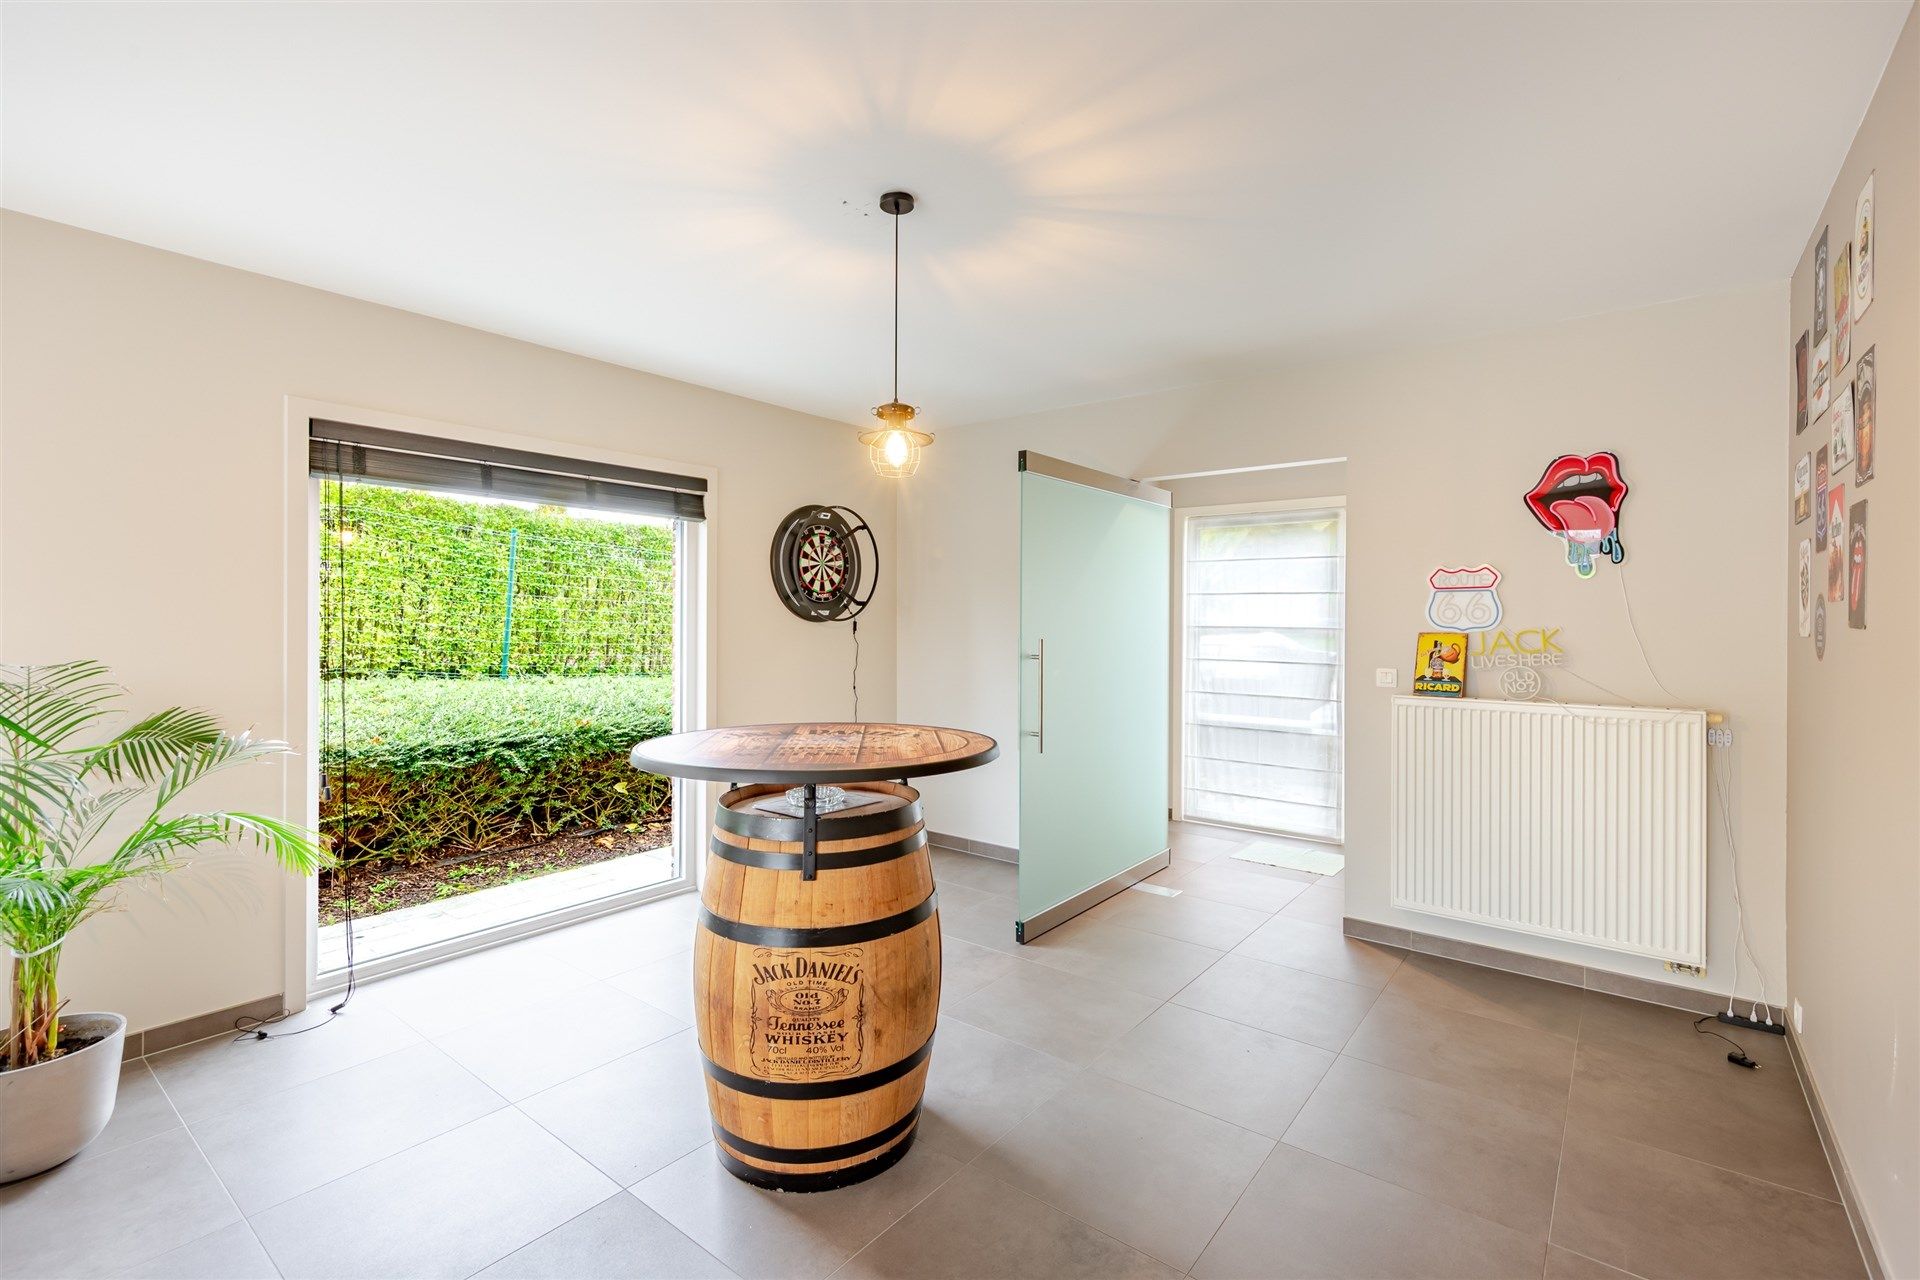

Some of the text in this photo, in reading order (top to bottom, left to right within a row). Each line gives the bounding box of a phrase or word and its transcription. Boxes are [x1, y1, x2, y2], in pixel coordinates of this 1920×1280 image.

[1437, 592, 1492, 624] 66
[1471, 628, 1564, 656] JACK
[1471, 652, 1563, 669] LIVES HERE
[1504, 670, 1536, 682] OLD
[1414, 682, 1461, 692] RICARD
[752, 957, 864, 985] JACK DANIEL'S
[767, 1015, 845, 1031] Tennessee
[764, 1032, 849, 1045] WHISKEY
[767, 1044, 846, 1055] 70cl 40% Vol.
